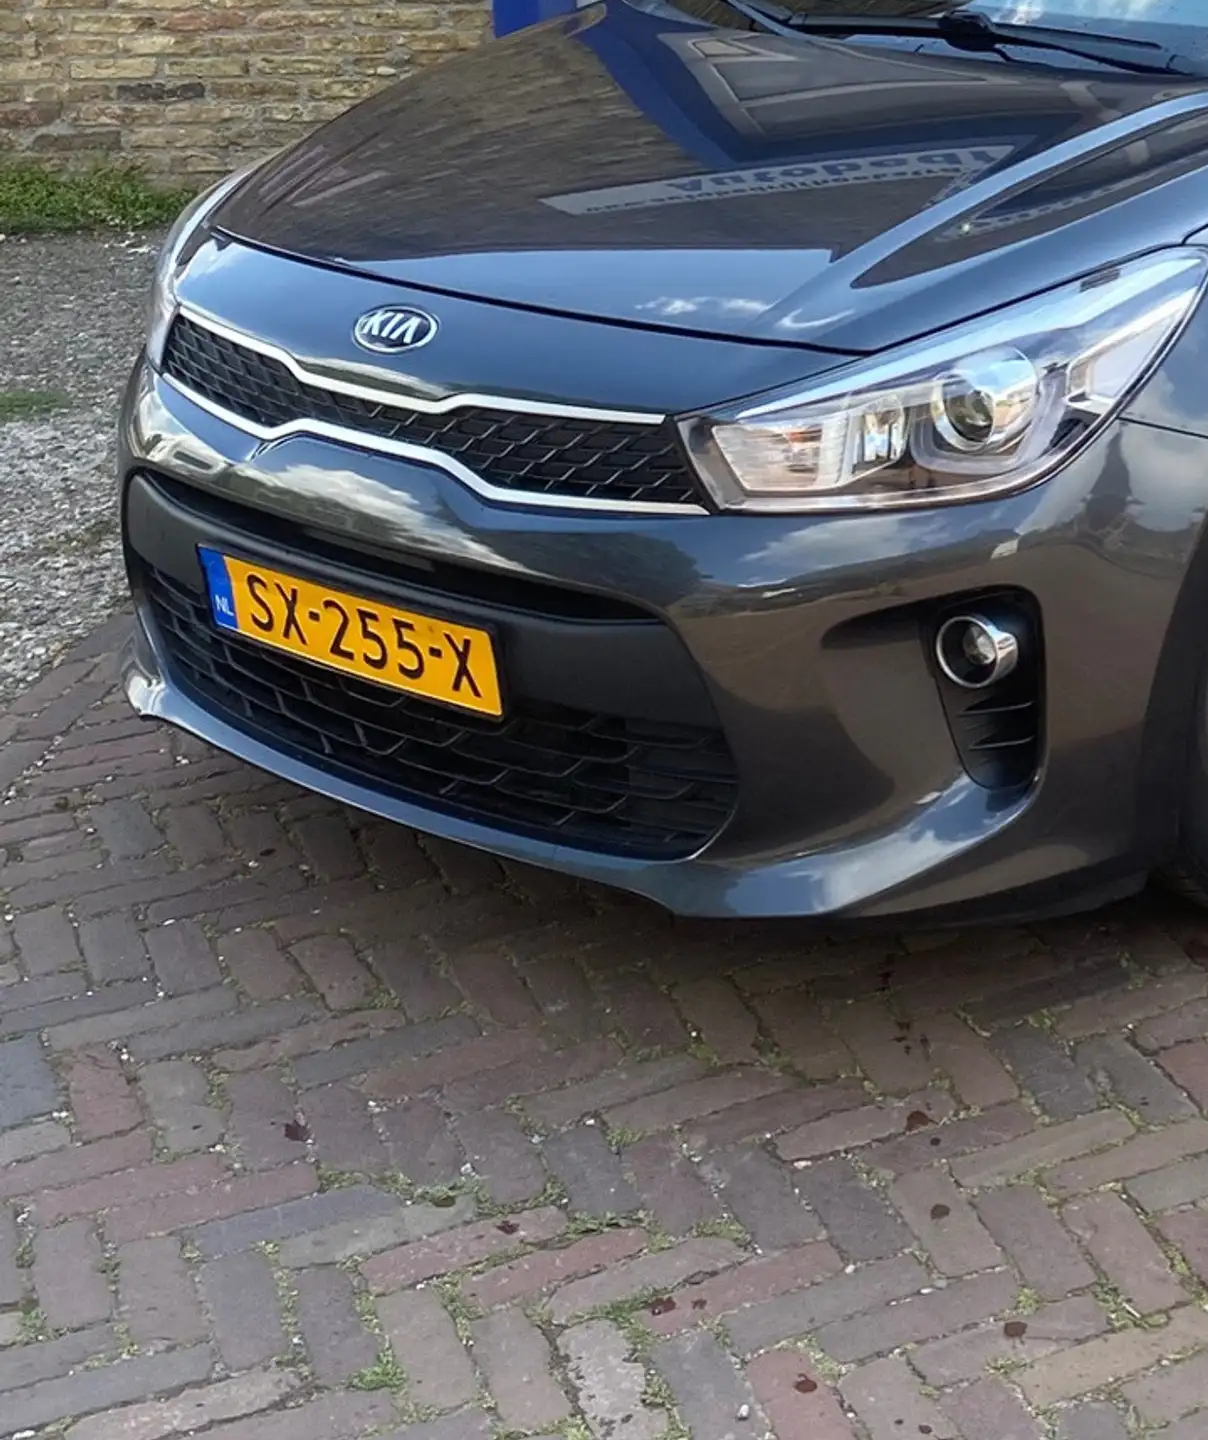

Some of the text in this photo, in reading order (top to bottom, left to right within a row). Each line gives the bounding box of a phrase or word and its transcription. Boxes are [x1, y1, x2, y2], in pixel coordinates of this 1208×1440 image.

[361, 310, 421, 344] KIA
[214, 594, 235, 617] NL
[245, 573, 483, 699] SX-255-X
